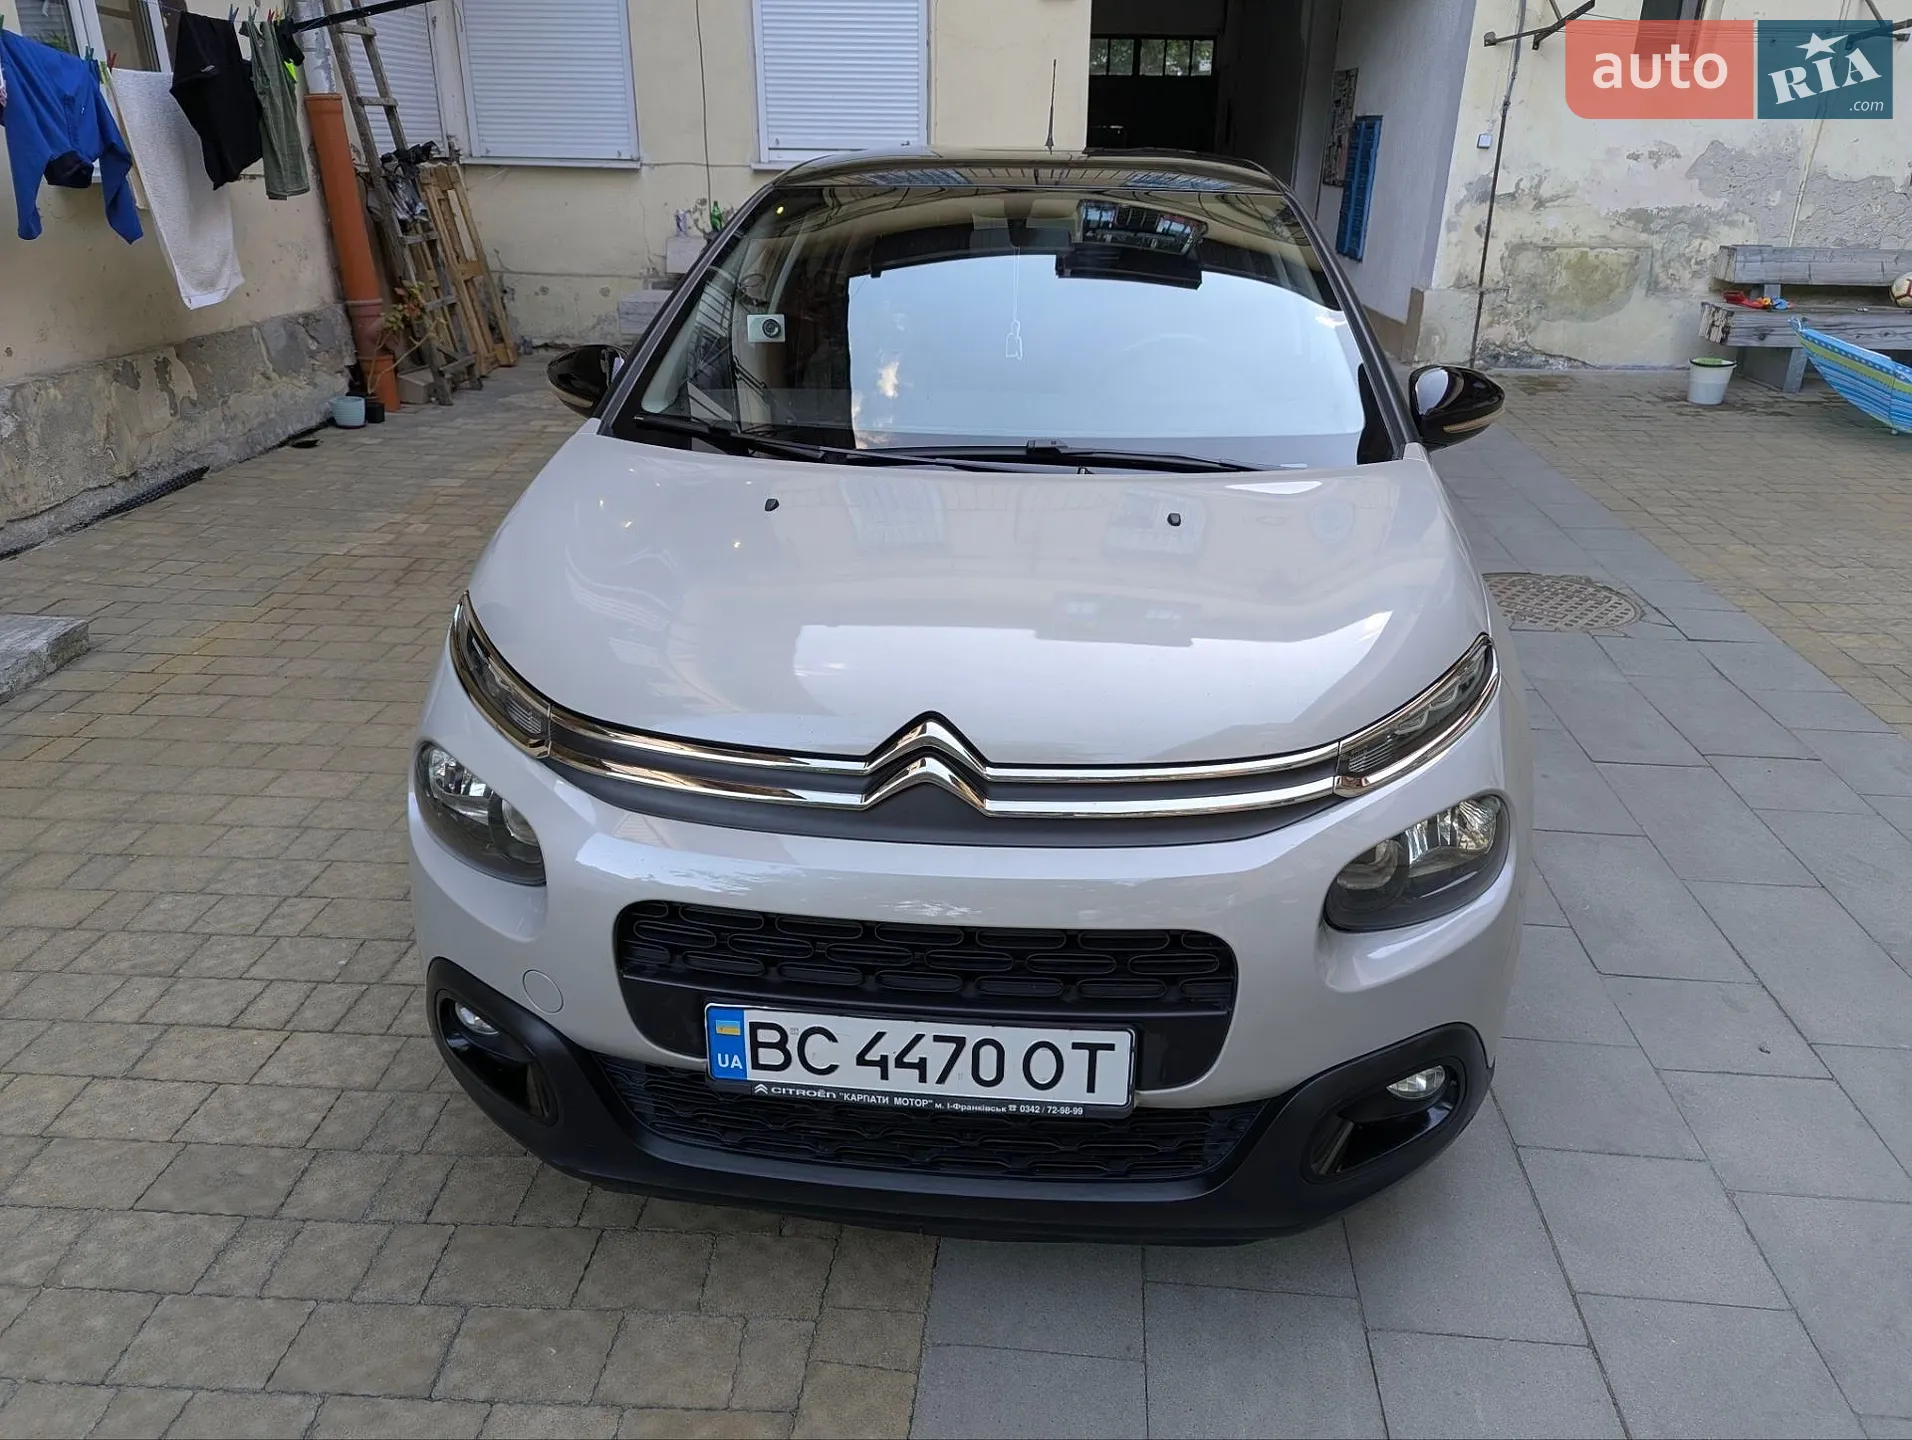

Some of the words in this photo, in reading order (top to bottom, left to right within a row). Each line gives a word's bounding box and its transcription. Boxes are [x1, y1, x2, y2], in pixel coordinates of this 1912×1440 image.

[717, 1053, 743, 1070] UA
[748, 1021, 840, 1076] BC
[855, 1030, 1005, 1088] 4470
[1022, 1040, 1116, 1094] OT
[1019, 1105, 1041, 1114] 0342
[1047, 1105, 1084, 1115] 72-98-99
